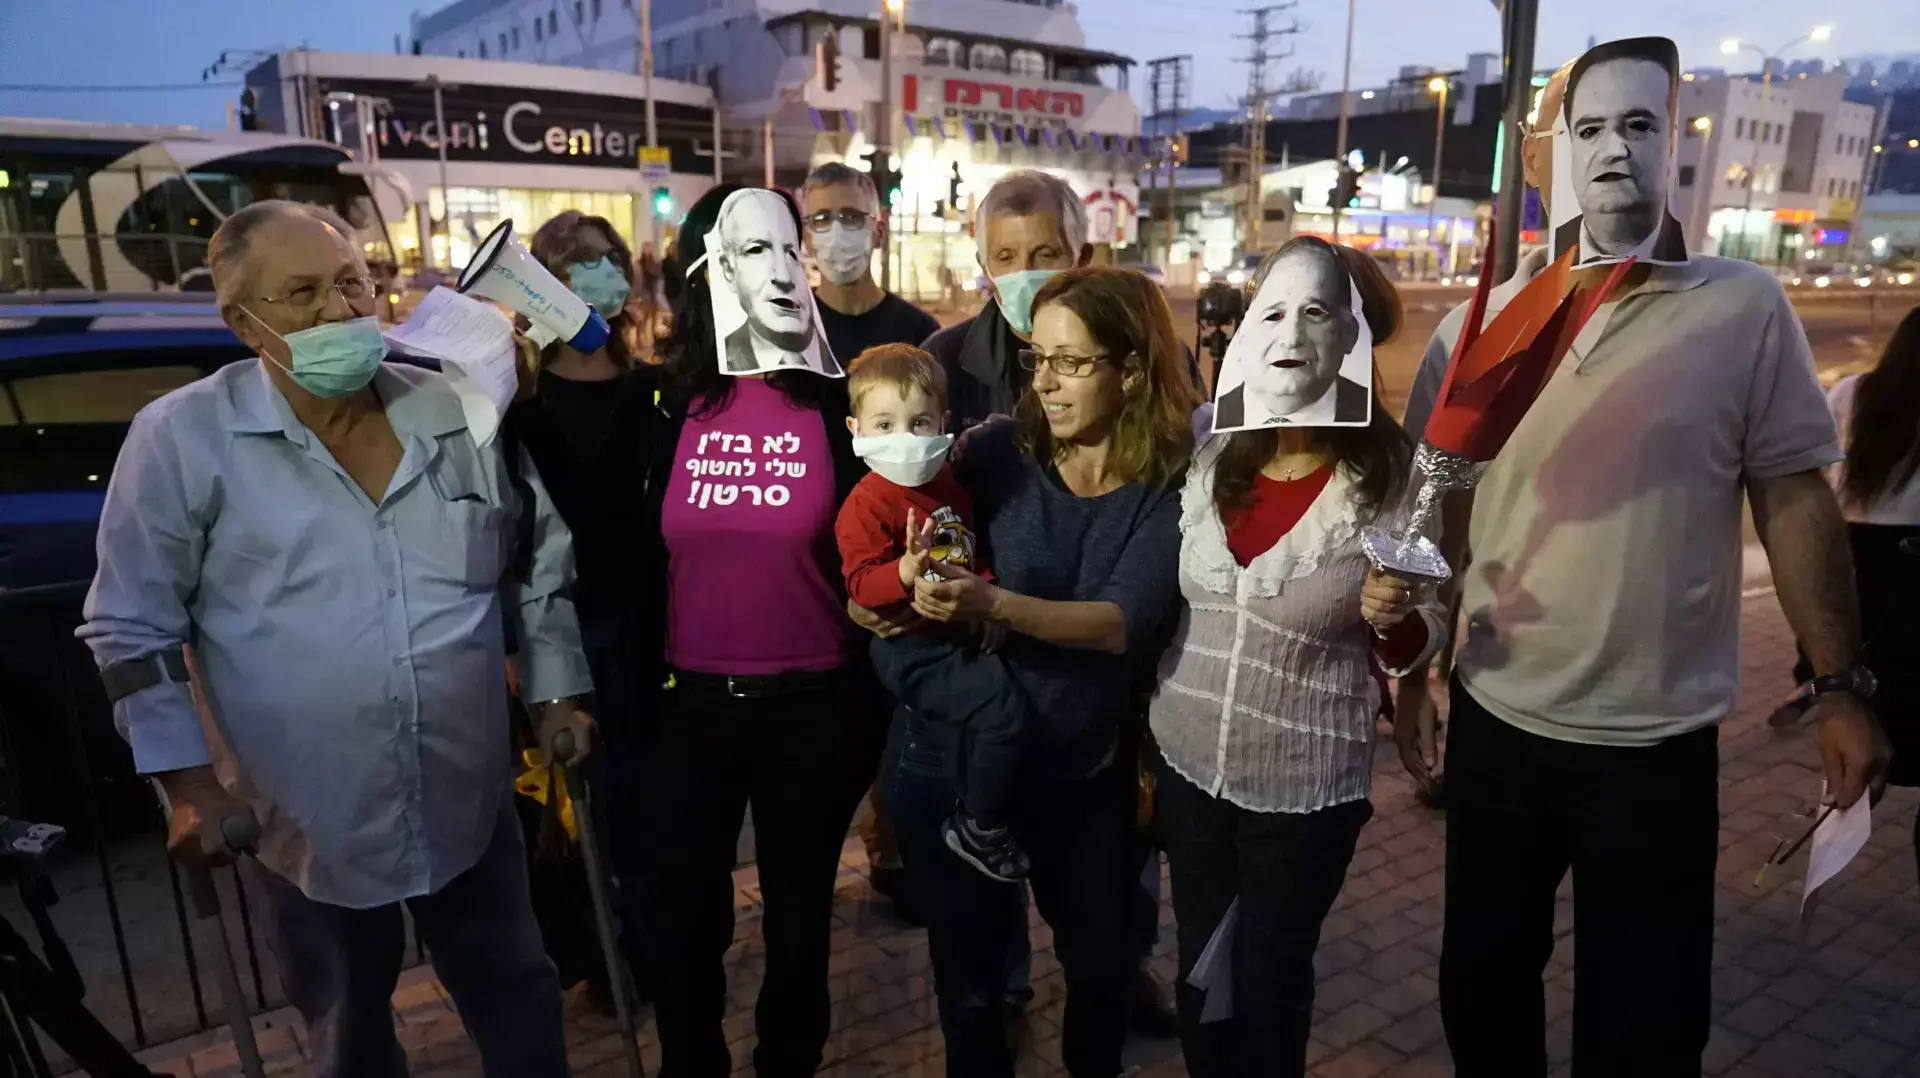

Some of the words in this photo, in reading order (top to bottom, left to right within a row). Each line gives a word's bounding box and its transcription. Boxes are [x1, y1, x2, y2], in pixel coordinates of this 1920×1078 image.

[503, 101, 641, 157] Center
[697, 431, 753, 455] בז"ן
[762, 431, 801, 454] לא
[685, 458, 757, 478] לחטוף
[764, 458, 807, 478] שלי
[687, 480, 791, 509] סרטן!
